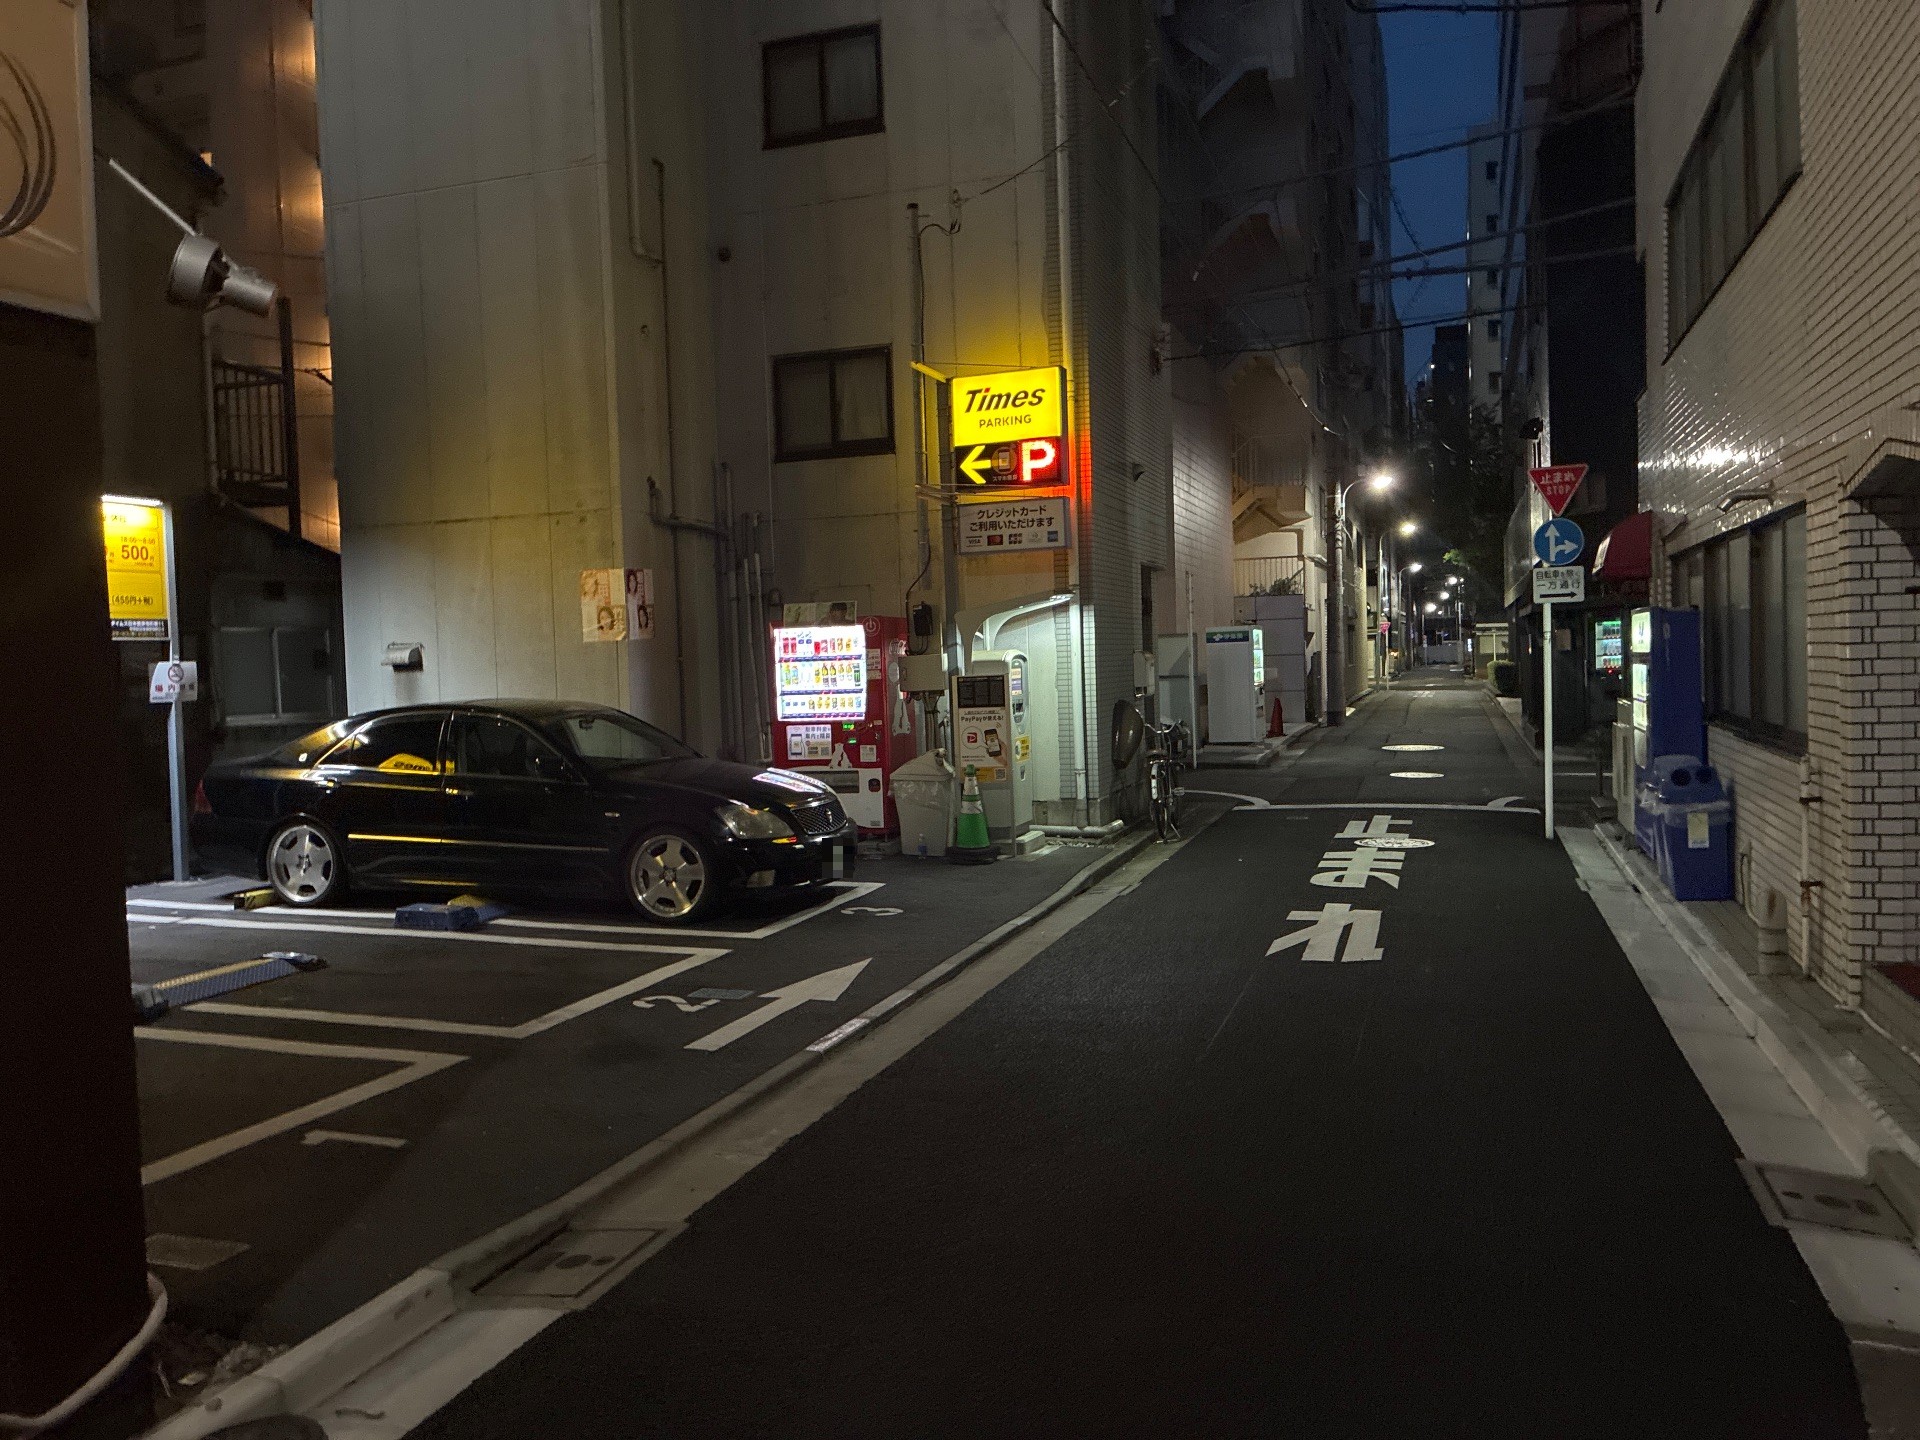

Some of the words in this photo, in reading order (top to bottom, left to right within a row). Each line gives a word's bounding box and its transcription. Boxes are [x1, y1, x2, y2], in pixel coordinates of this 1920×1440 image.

[965, 387, 1045, 413] Times
[979, 414, 1032, 428] PARKING
[1021, 440, 1055, 481] P
[1540, 471, 1576, 485] 止まれ
[1547, 485, 1571, 496] STOP
[977, 506, 1047, 520] クレジットカード
[969, 517, 1054, 531] ご利用いただけます
[1537, 580, 1581, 589] 一方通行
[1265, 815, 1413, 962] 止まれ
[633, 995, 720, 1012] 2
